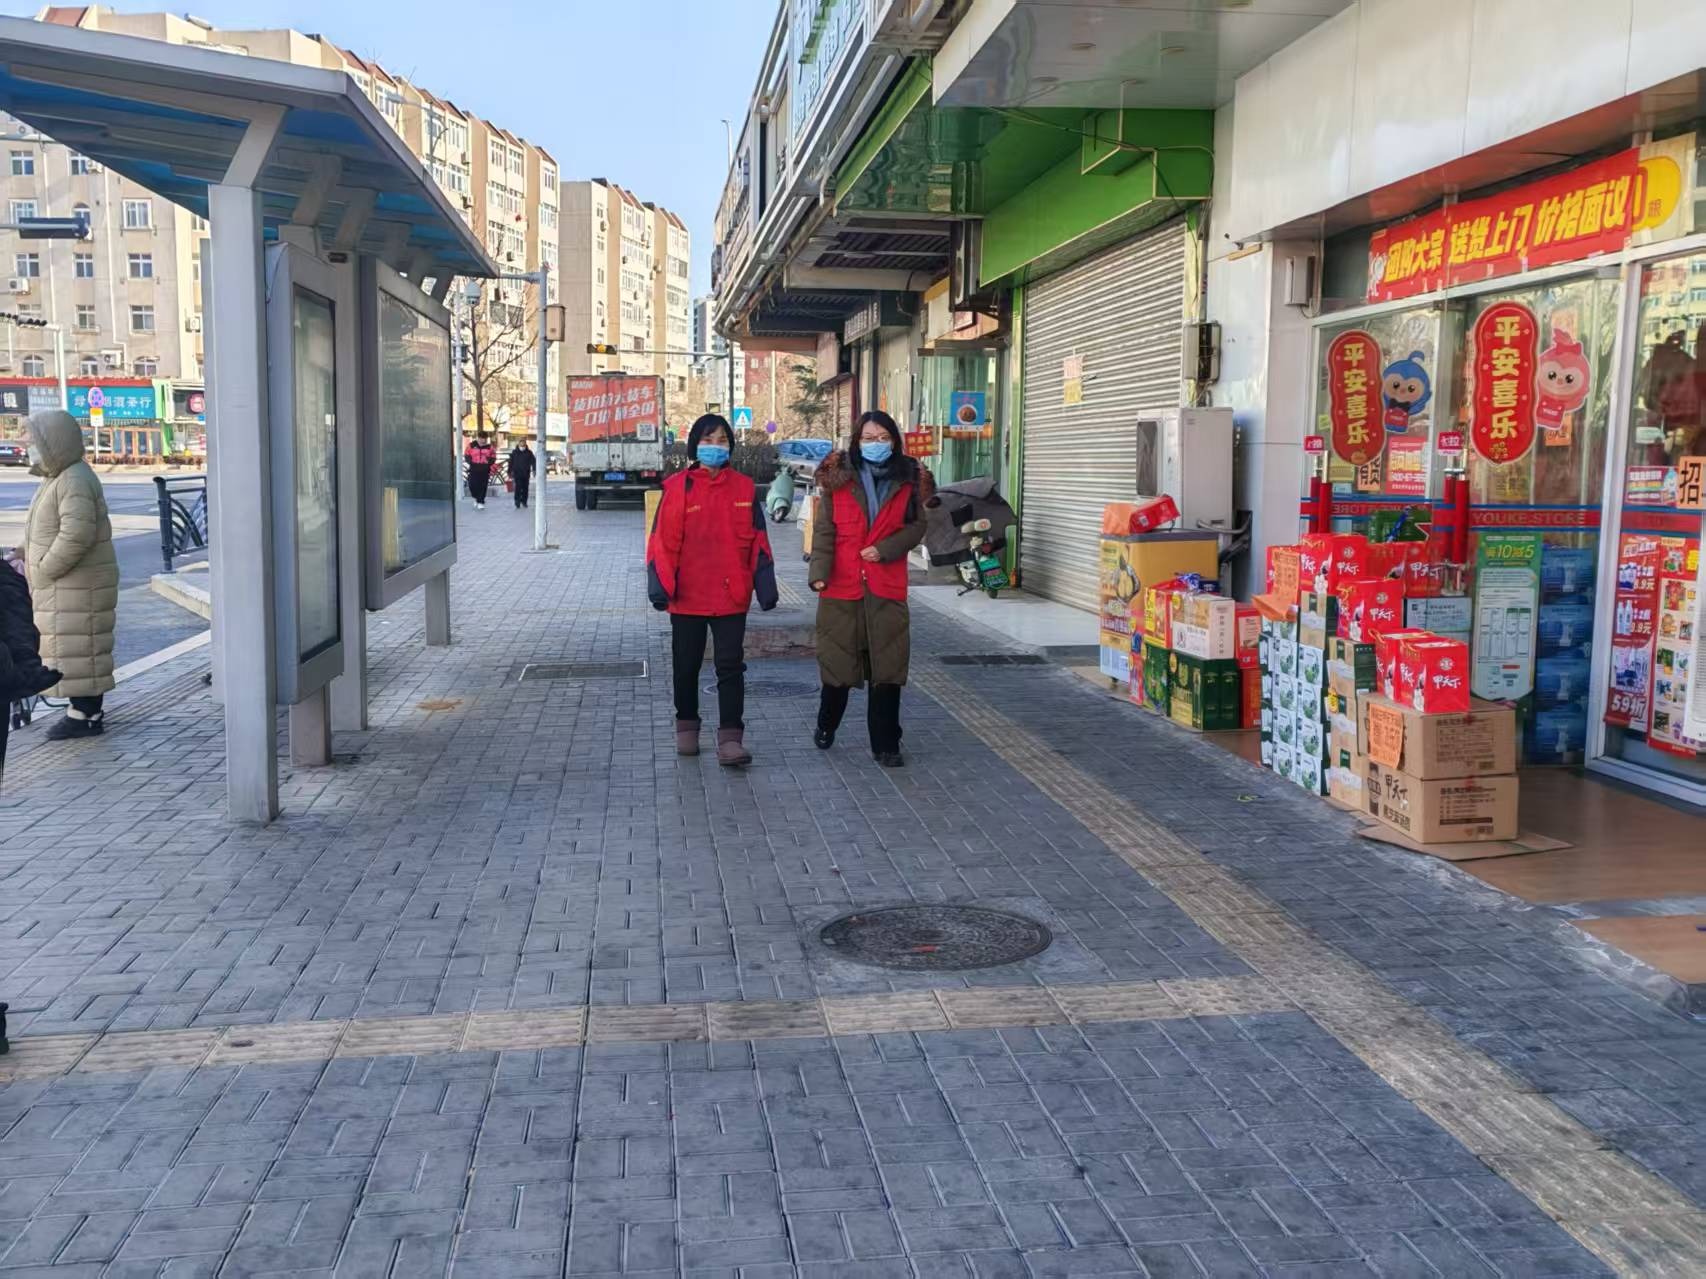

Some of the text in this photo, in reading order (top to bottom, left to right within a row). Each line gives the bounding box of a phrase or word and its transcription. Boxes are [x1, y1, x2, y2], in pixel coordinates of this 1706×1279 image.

[1448, 203, 1534, 264] 送货上门
[1534, 175, 1632, 247] 价格面议
[1343, 342, 1370, 445] 平安喜乐
[1490, 314, 1521, 440] 平安喜乐
[1533, 512, 1586, 524] STORE
[1680, 461, 1700, 505] 招
